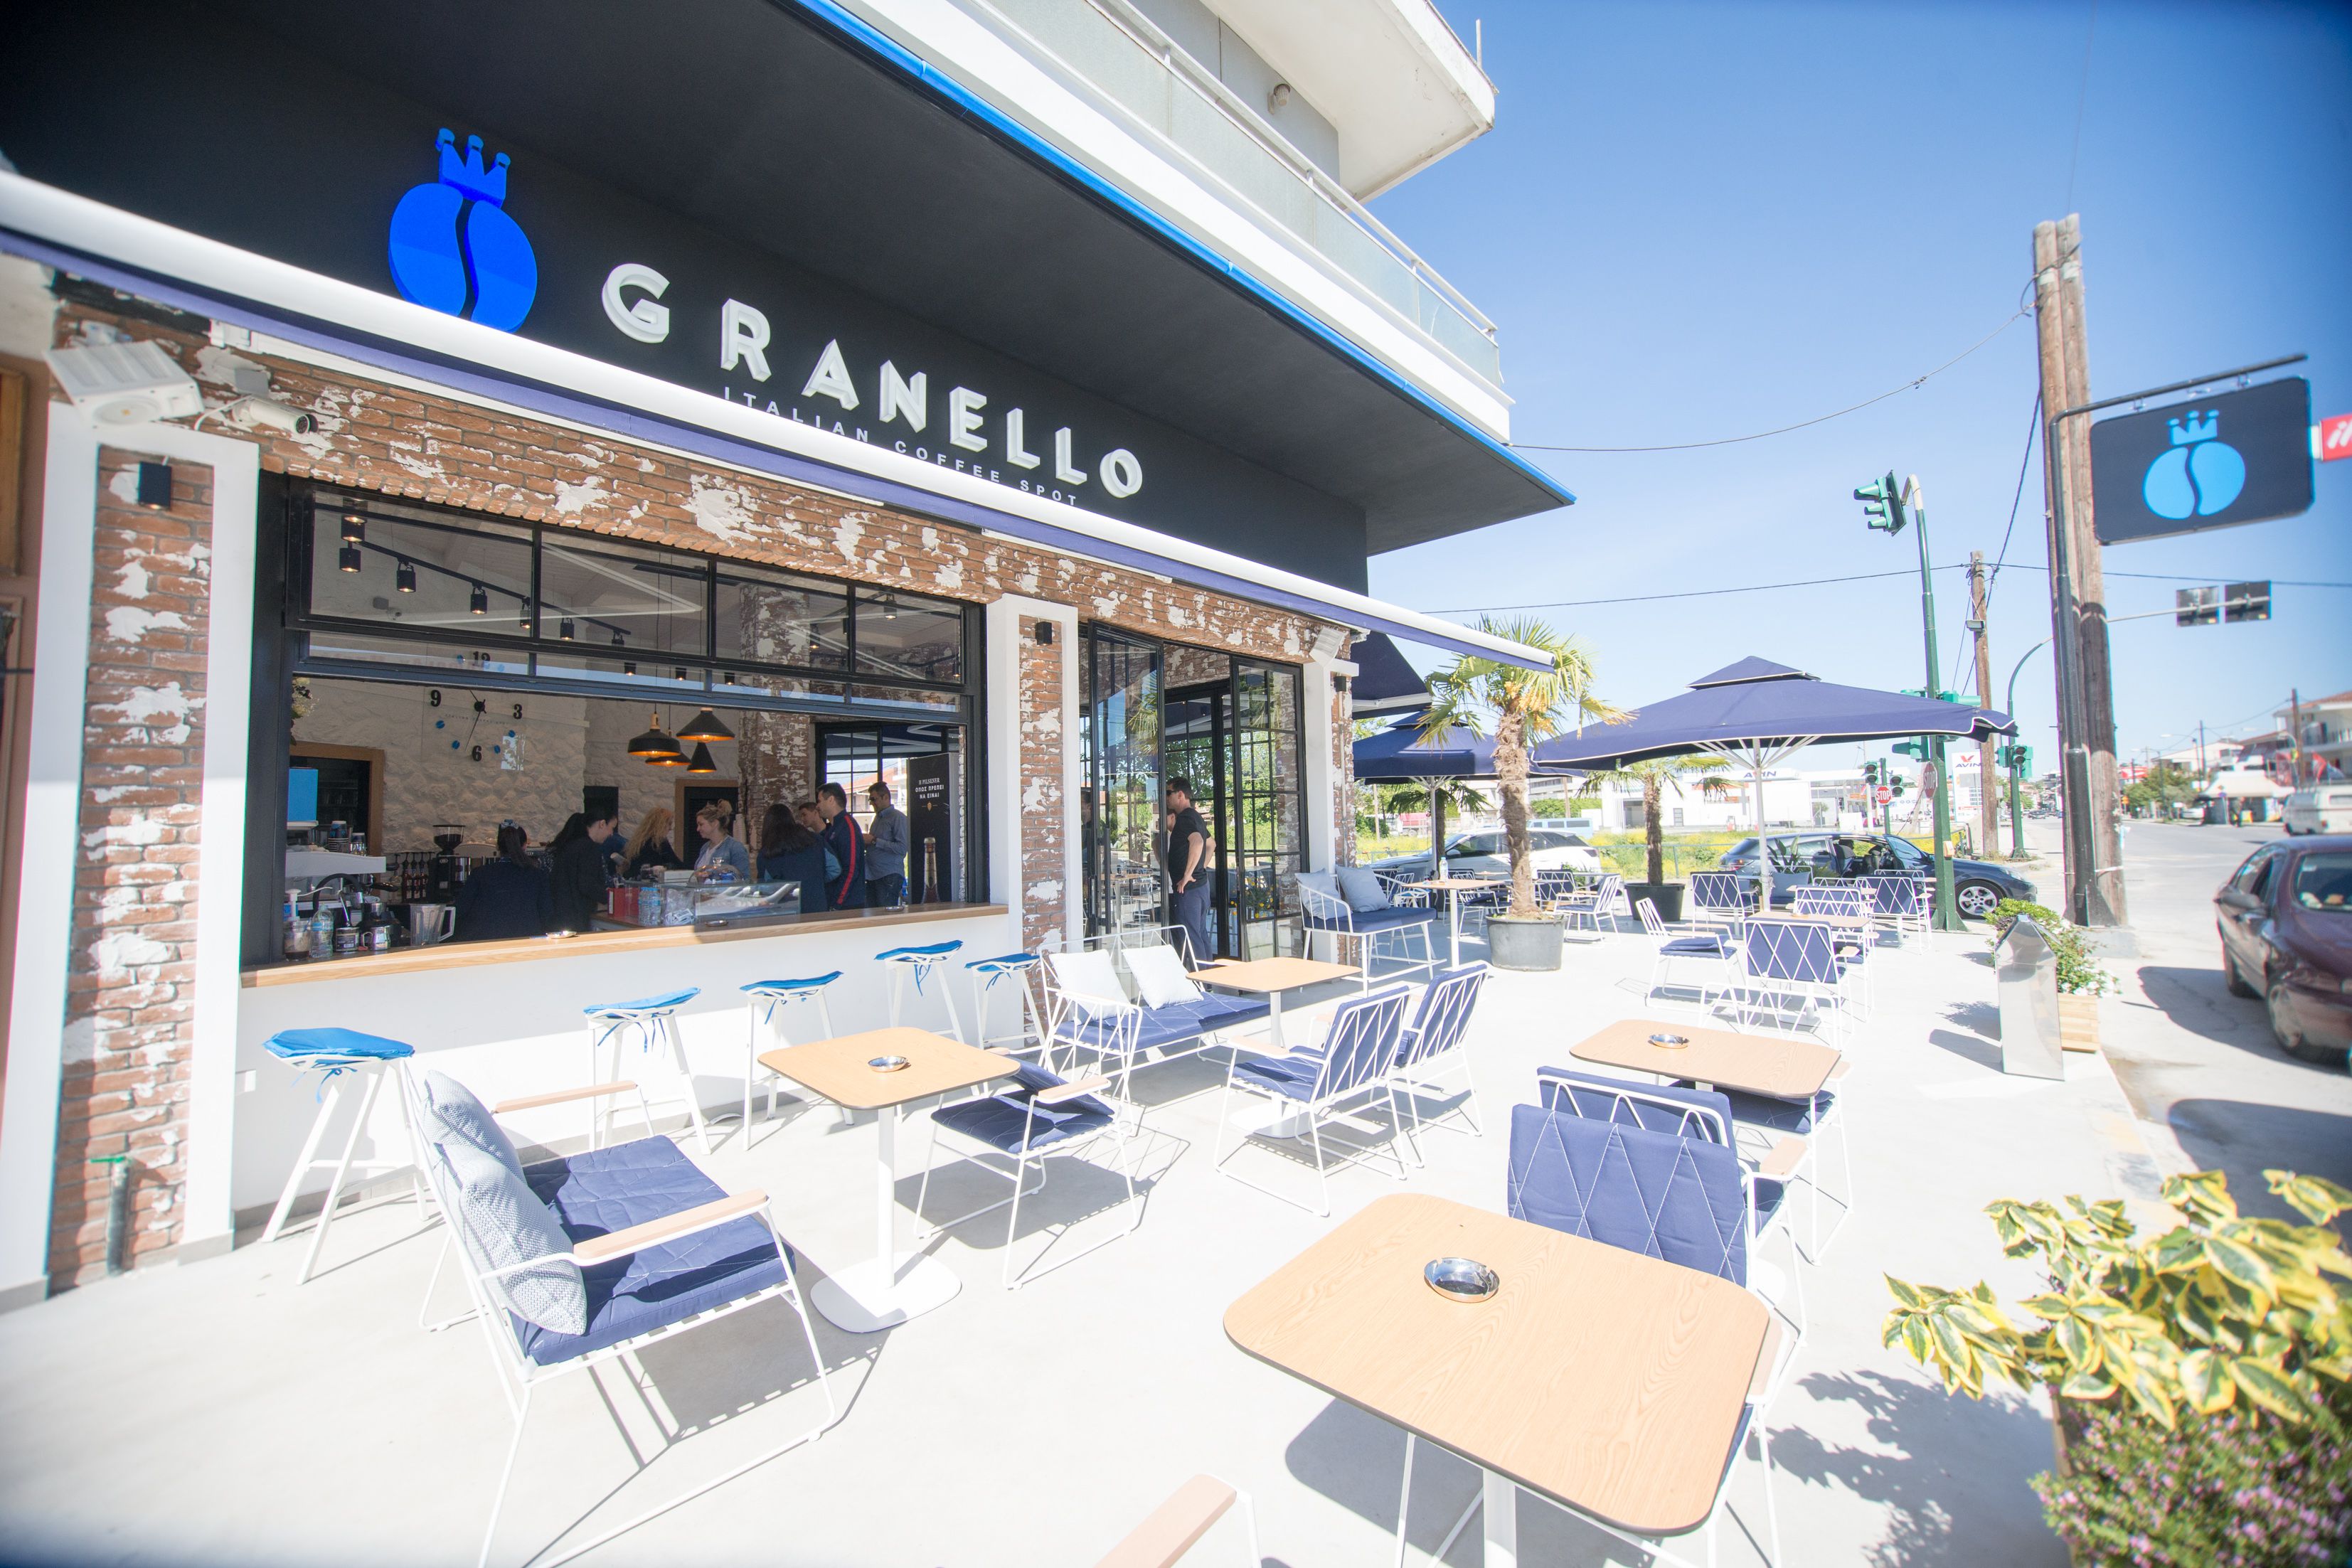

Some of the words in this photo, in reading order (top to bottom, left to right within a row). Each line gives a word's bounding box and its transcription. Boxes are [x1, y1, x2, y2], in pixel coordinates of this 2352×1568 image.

[601, 262, 1143, 498] GRANELLO
[725, 386, 868, 442] ITALIAN
[894, 440, 1000, 483] COFFEE
[1020, 479, 1076, 506] SPOT
[430, 689, 442, 707] 9
[513, 703, 523, 719] 3
[472, 745, 482, 762] 6
[1923, 771, 1936, 789] STOP
[1875, 790, 1891, 801] STOP
